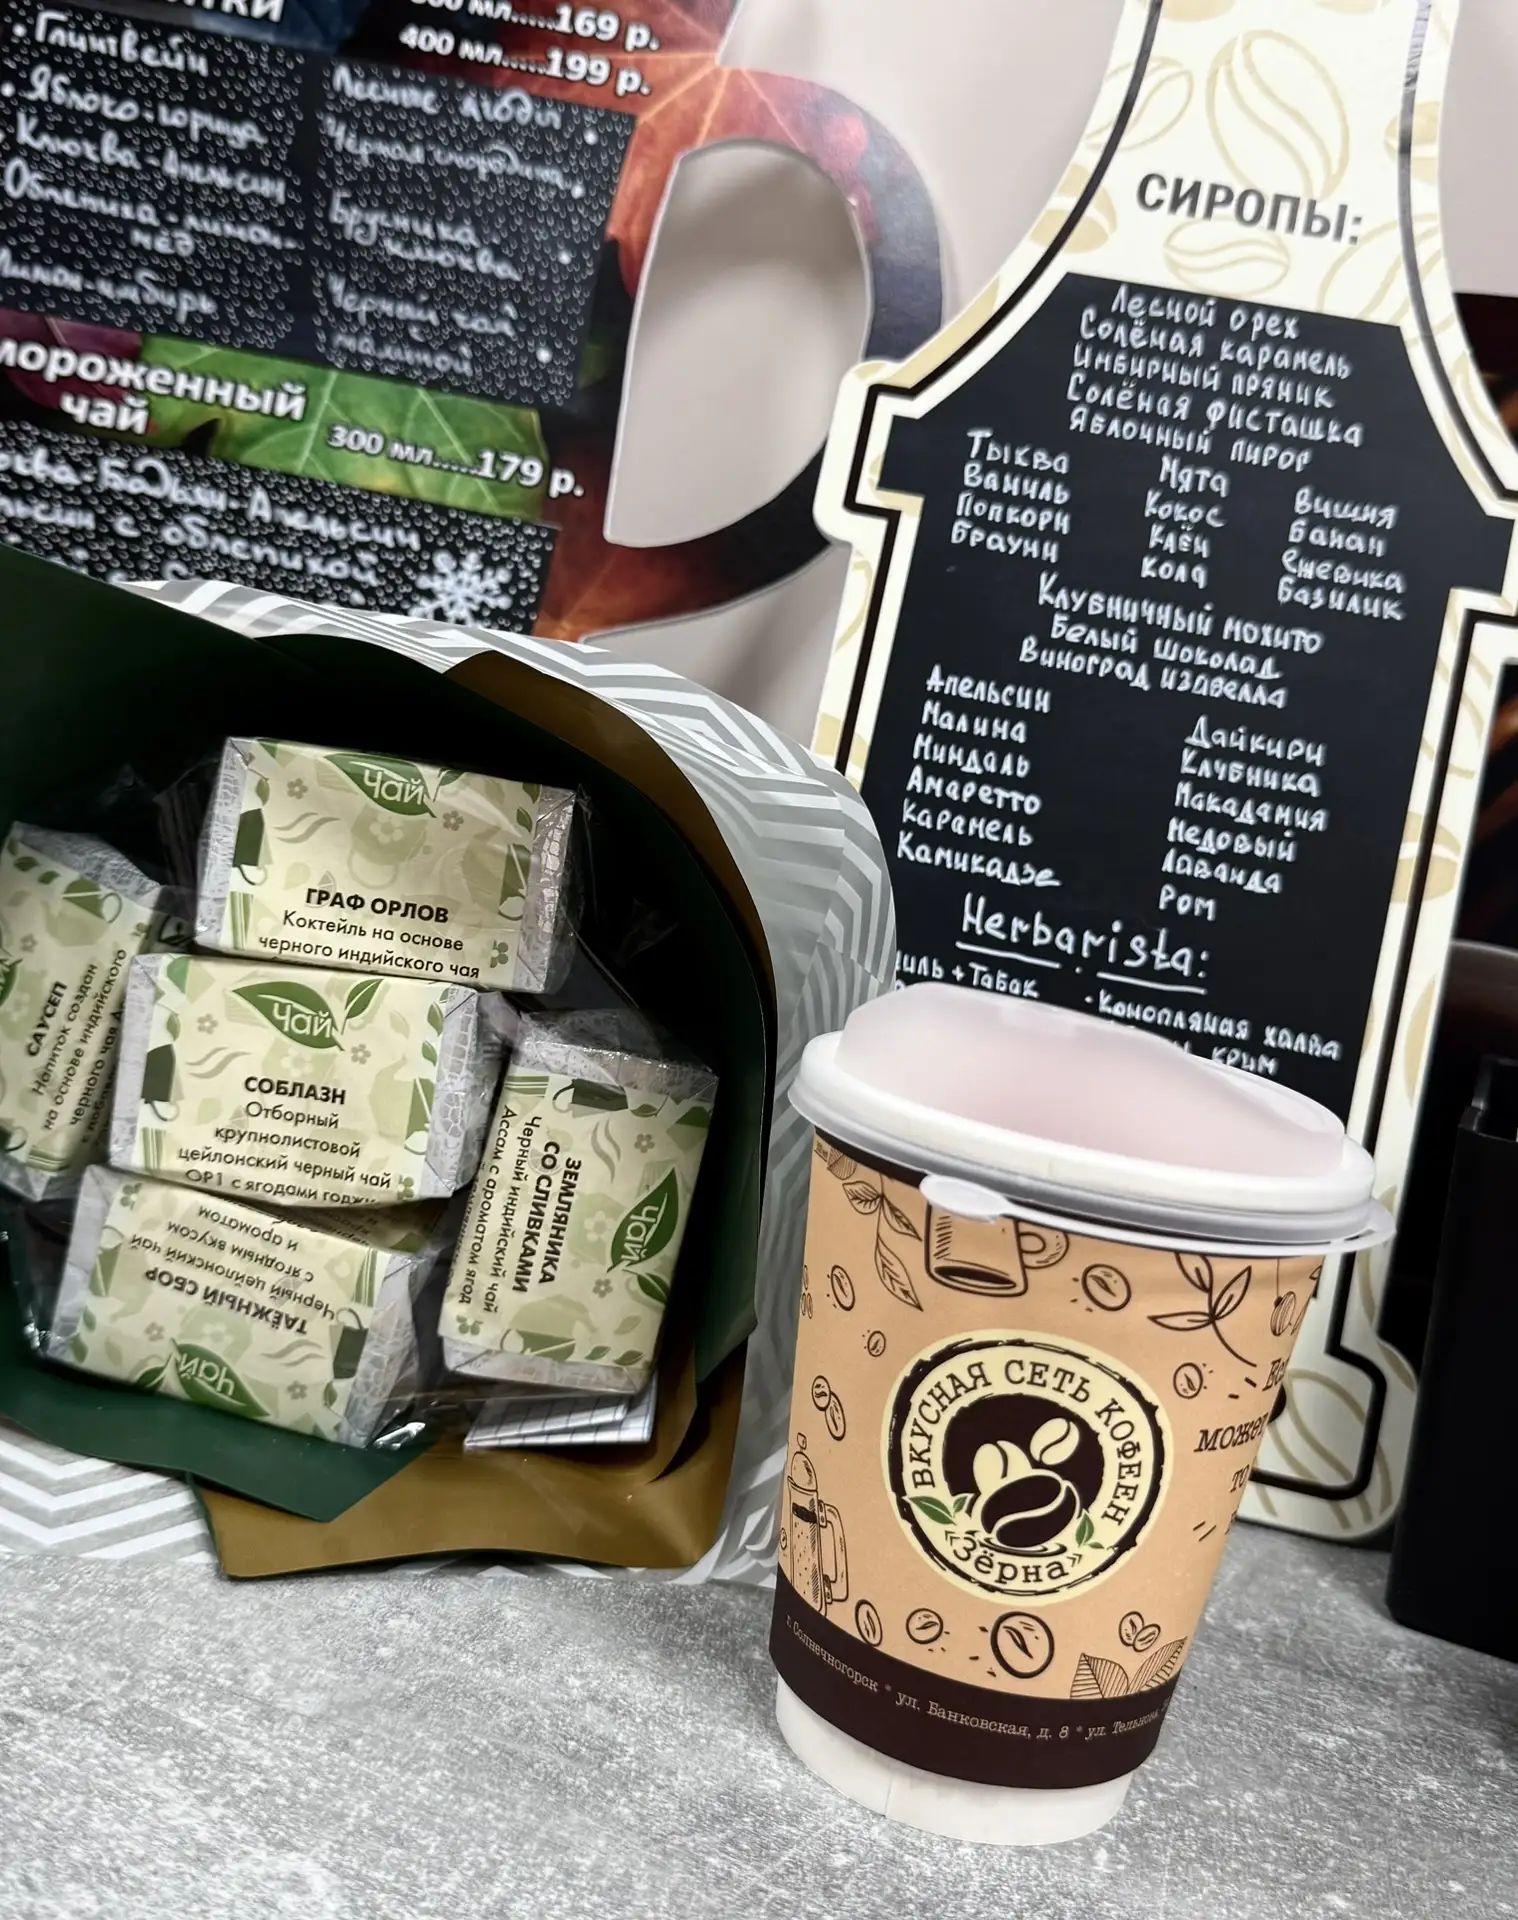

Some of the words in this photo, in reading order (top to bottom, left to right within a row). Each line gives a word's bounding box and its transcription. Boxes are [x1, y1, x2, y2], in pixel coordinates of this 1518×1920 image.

[399, 23, 455, 55] 400
[1136, 172, 1363, 245] СИРОПЫ:
[60, 393, 150, 435] чай
[328, 425, 383, 455] 300
[305, 887, 366, 911] ГРАФ
[370, 897, 450, 924] ОРЛОВ
[282, 908, 369, 938] Коктейль
[371, 927, 395, 942] на
[399, 931, 465, 953] основе
[258, 935, 334, 958] черного
[337, 946, 444, 976] индийского
[449, 962, 481, 980] чая
[26, 981, 68, 1056] САУСЕП
[32, 1026, 71, 1098] Напиток
[68, 963, 98, 1023] создан
[44, 1108, 60, 1131] на
[54, 1047, 84, 1106] основе
[81, 949, 127, 1045] индийского
[70, 1058, 106, 1127] черного
[102, 1026, 119, 1054] чая
[244, 1075, 347, 1105] СОБЛАЗН
[245, 1101, 341, 1129] Отборный
[493, 1105, 518, 1160] Ассам
[214, 1125, 362, 1158] крупнолистовой
[512, 1116, 542, 1182] Черный
[540, 1141, 560, 1169] СО
[178, 1146, 290, 1172] цейлонский
[293, 1159, 356, 1184] черный
[359, 1171, 392, 1190] чай
[231, 1178, 241, 1190] с
[245, 1180, 318, 1201] ягодами
[489, 1165, 500, 1175] с
[167, 1221, 227, 1252] вкусом
[198, 1205, 283, 1244] ароматом
[469, 1178, 497, 1265] ароматом
[490, 1186, 520, 1279] индийский
[512, 1174, 552, 1293] СЛИВКАМИ
[538, 1157, 581, 1285] ЗЕМЛЯНИКА
[130, 1233, 162, 1254] чай
[231, 1245, 302, 1280] ягодным
[288, 1241, 299, 1252] и
[144, 1267, 199, 1296] СБОР
[164, 1247, 265, 1291] цейлонский
[305, 1271, 314, 1283] с
[459, 1269, 477, 1304] ягод
[203, 1285, 308, 1335] ТАЁЖНЫЙ
[270, 1285, 336, 1321] Черный
[484, 1282, 499, 1313] чай
[1004, 1359, 1091, 1403] СЕТЬ
[909, 1362, 992, 1489] ВКУСНАЯ
[1095, 1398, 1141, 1526] КОФЕЕН
[793, 1621, 879, 1692] Солнечногорск
[895, 1692, 920, 1710] ул.
[927, 1700, 1032, 1739] Банковская,
[1036, 1728, 1052, 1740] д.
[1058, 1725, 1069, 1739] 8
[1085, 1726, 1106, 1740] ул.
